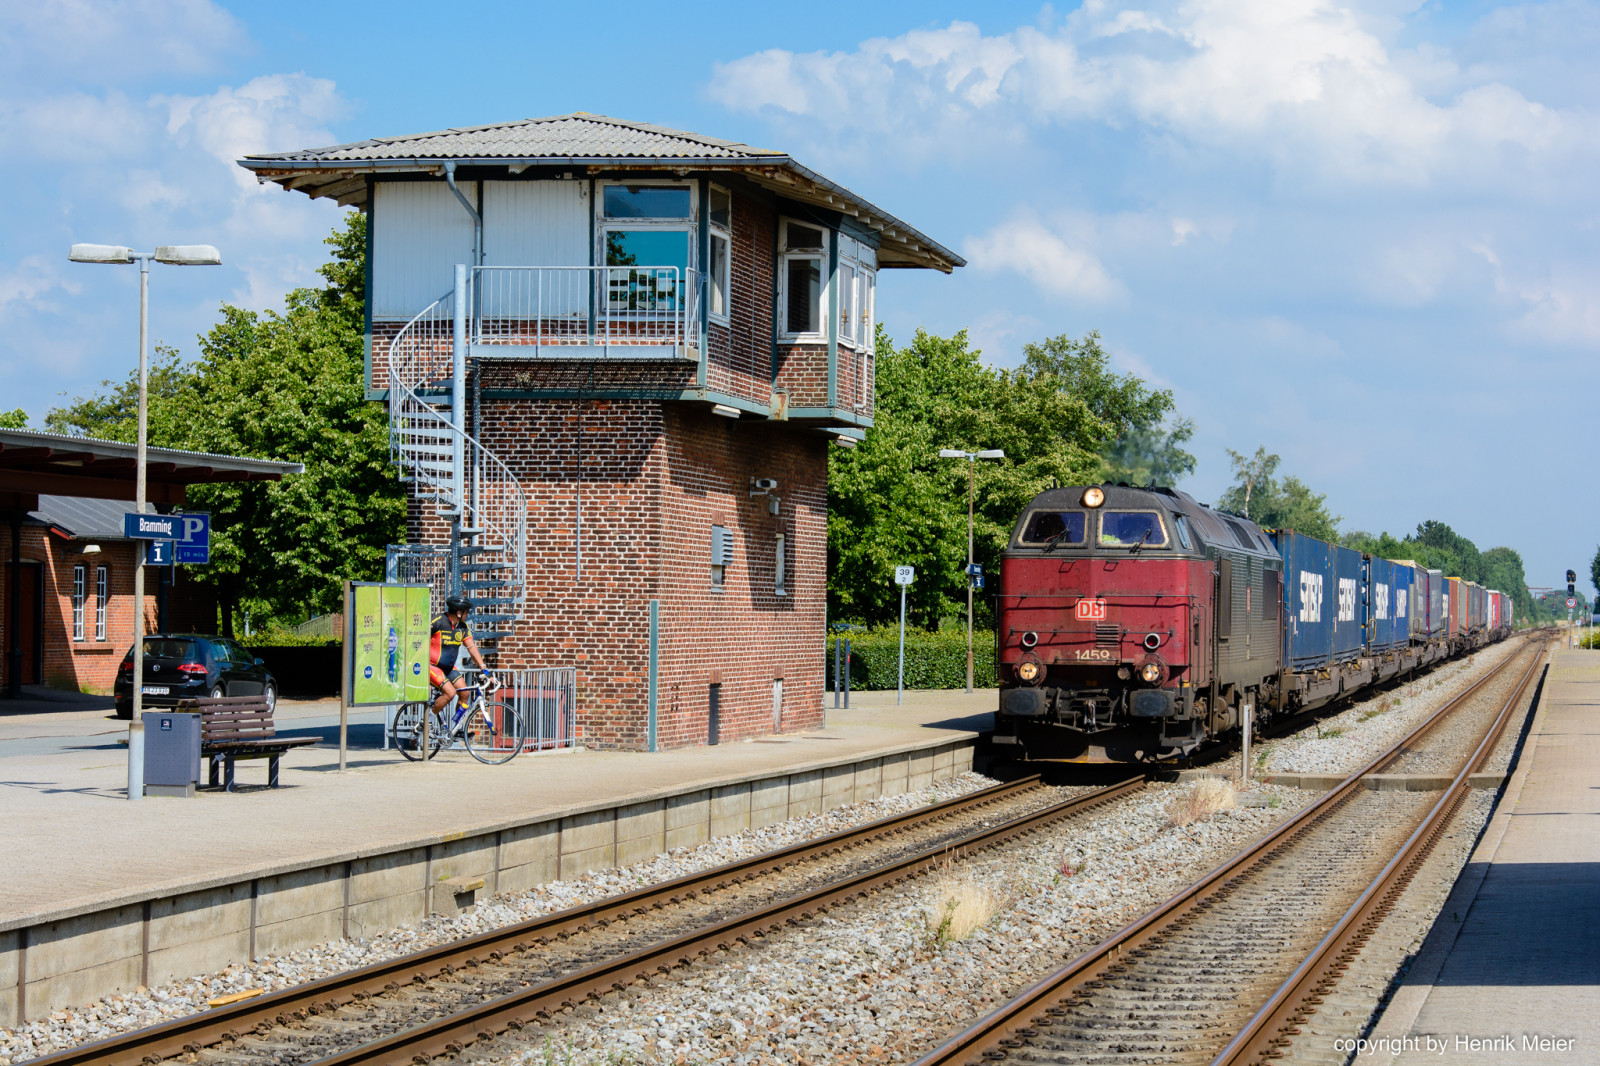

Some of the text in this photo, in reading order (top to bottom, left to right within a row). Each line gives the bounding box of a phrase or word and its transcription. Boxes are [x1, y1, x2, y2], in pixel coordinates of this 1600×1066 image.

[139, 517, 172, 536] Bramming
[182, 517, 204, 542] P
[154, 548, 163, 562] 1
[899, 568, 910, 576] 39
[1079, 601, 1103, 617] DB
[1074, 650, 1110, 661] 1459
